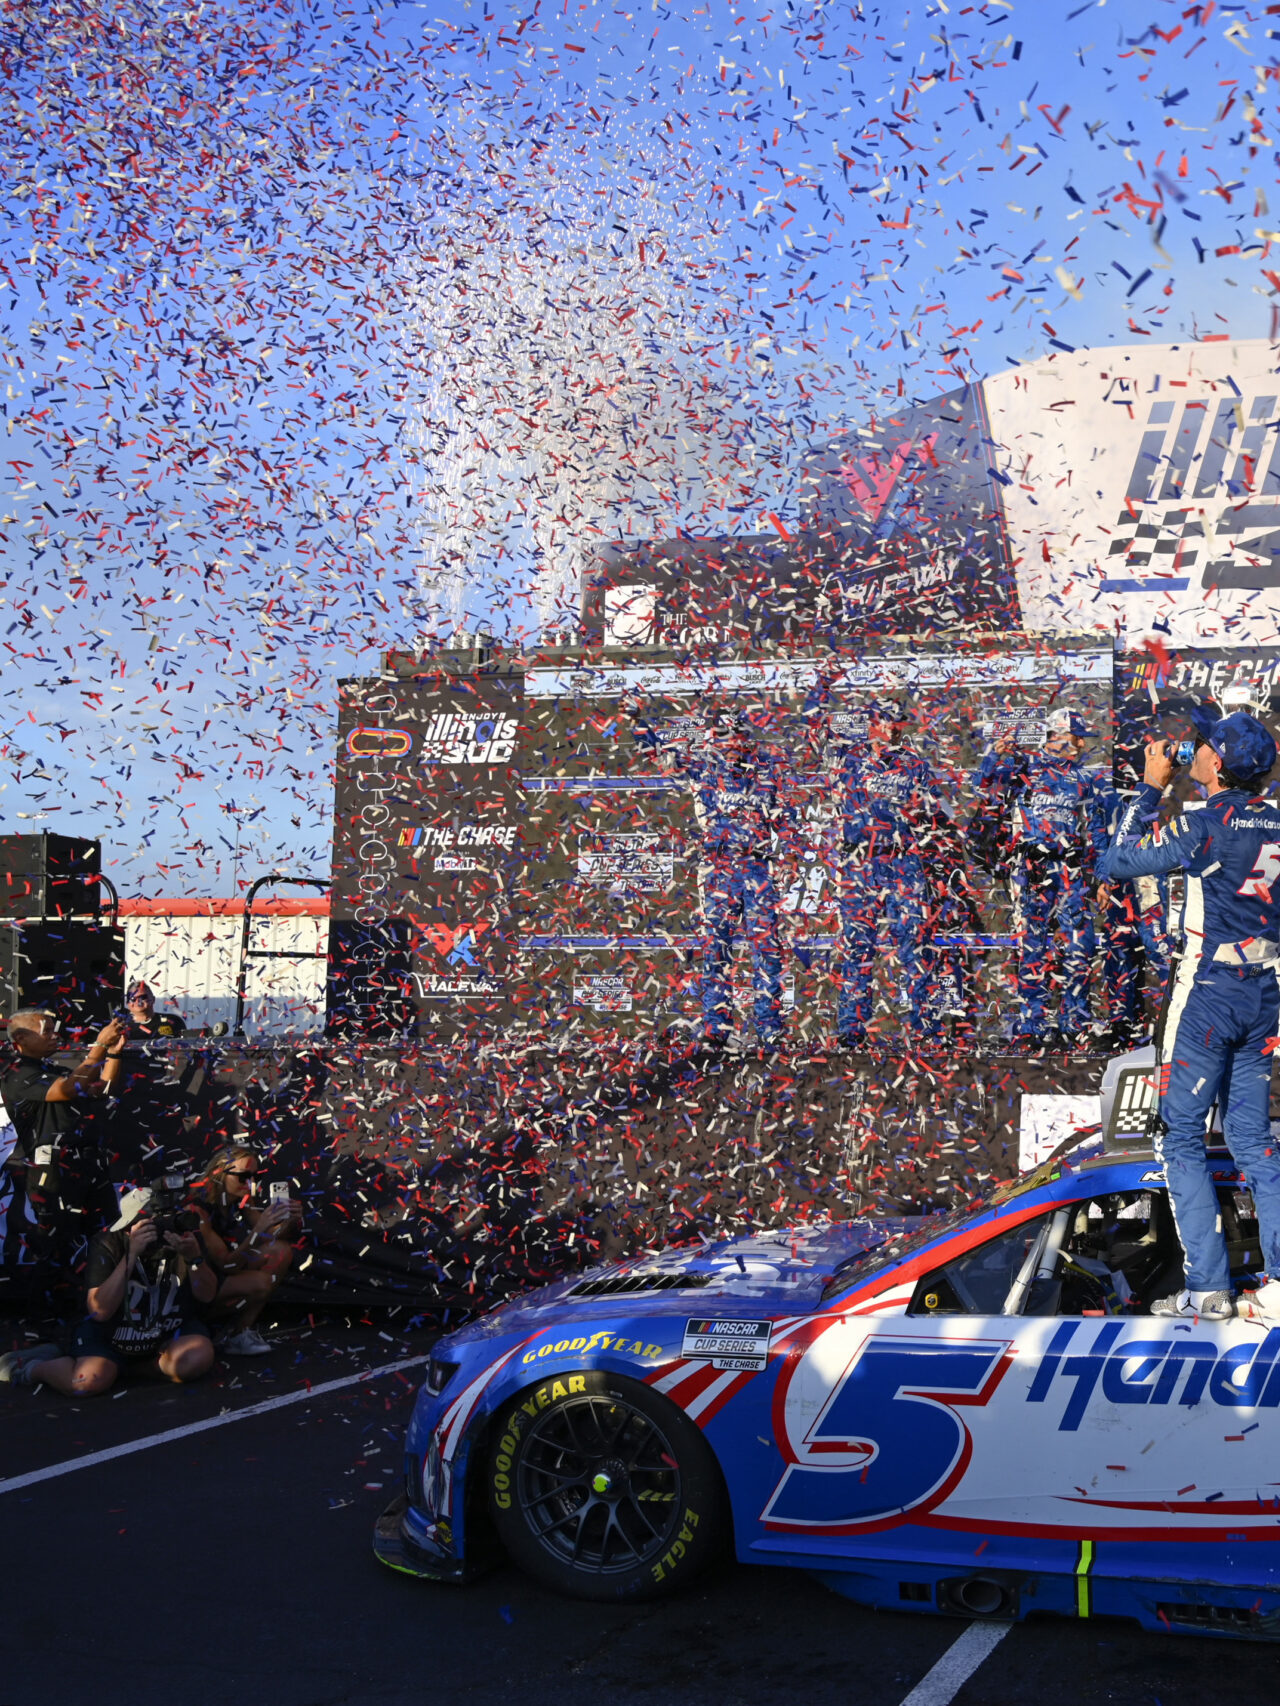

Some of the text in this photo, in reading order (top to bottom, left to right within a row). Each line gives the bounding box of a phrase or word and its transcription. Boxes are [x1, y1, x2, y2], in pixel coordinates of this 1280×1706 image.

[1169, 661, 1225, 687] THE
[424, 826, 518, 846] THE CHASE
[711, 1322, 759, 1336] NASCAR
[522, 1331, 663, 1365] GOODYEAR
[694, 1338, 756, 1352] CUP SERIES
[719, 1359, 761, 1370] THE CHASE
[495, 1374, 587, 1509] GOODYEAR
[758, 1334, 1018, 1532] 5
[652, 1507, 700, 1583] EAGLE
